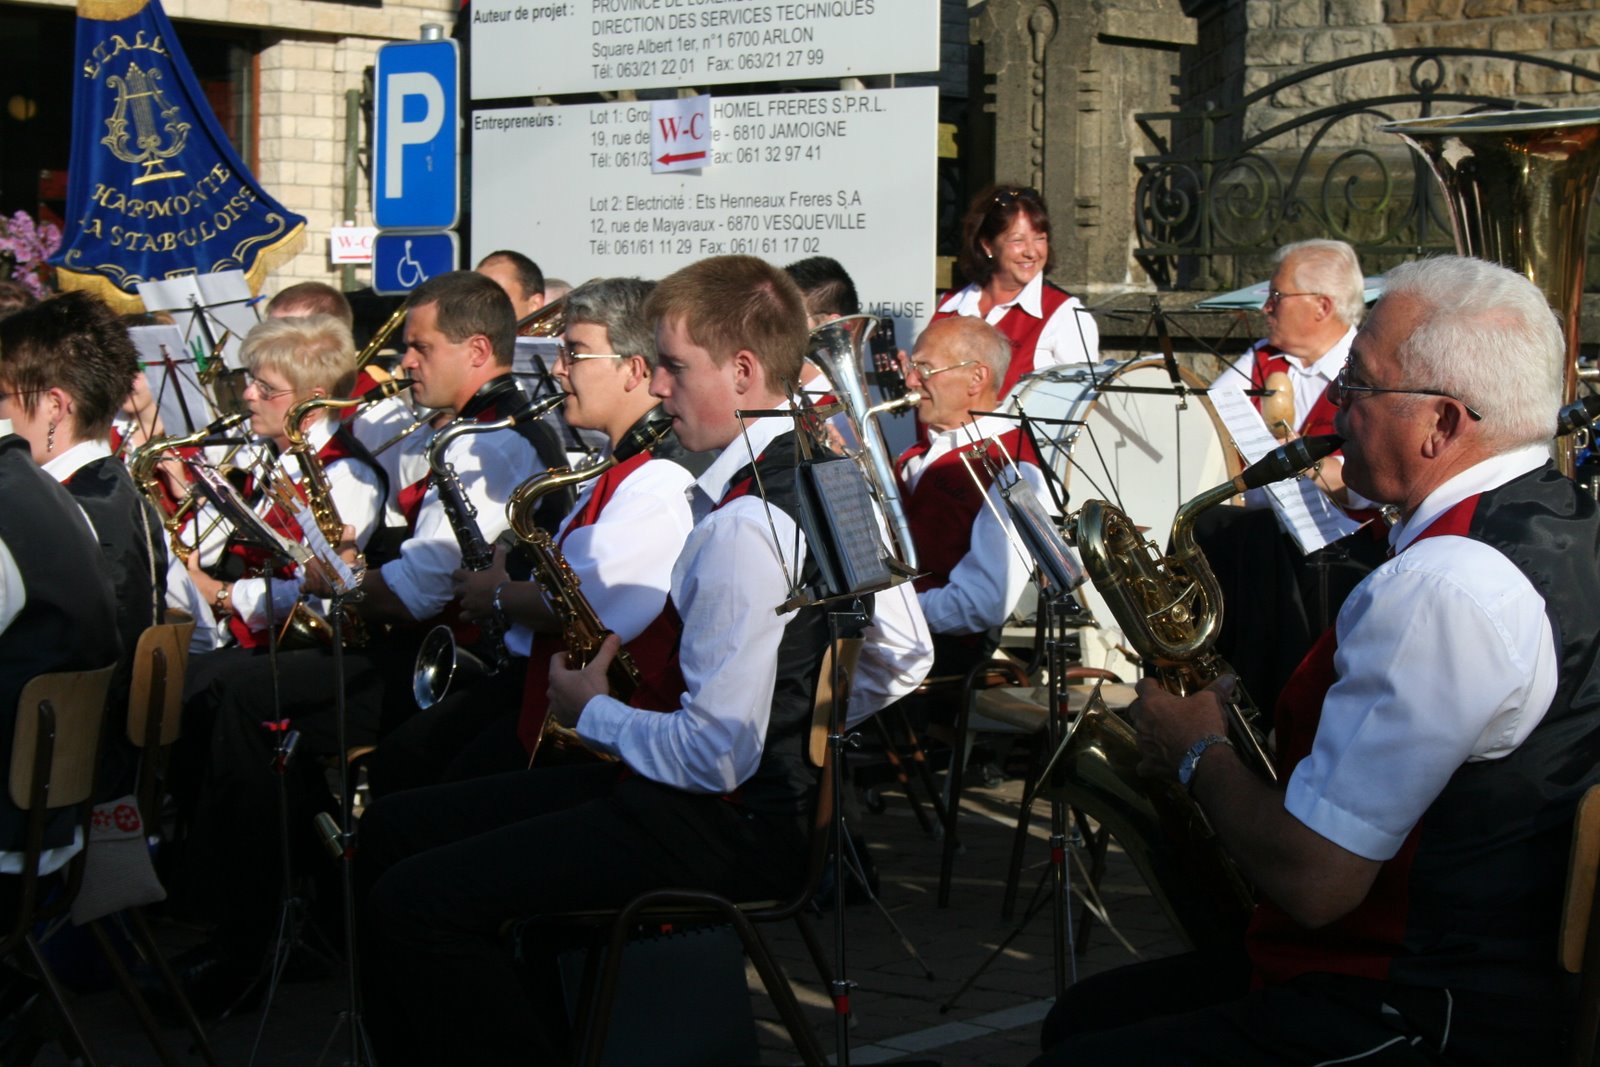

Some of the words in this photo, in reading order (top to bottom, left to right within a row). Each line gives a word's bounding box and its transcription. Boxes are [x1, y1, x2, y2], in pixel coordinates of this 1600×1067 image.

[473, 9, 511, 24] Auteur
[514, 6, 528, 20] de
[532, 3, 567, 23] projet
[592, 0, 660, 14] PROVINCE
[592, 16, 664, 36] DIRECTION
[668, 13, 697, 30] DES
[700, 6, 772, 27] SERVICES
[776, 0, 875, 21] TECHNIQUES
[84, 30, 171, 79] ETALL
[592, 42, 634, 60] Square
[637, 38, 672, 54] Albert
[677, 36, 699, 52] 1er,
[703, 34, 723, 50] n°1
[728, 30, 760, 48] 6700
[762, 27, 814, 45] ARLON
[592, 63, 613, 79] Tél:
[616, 61, 656, 78] 063/21
[661, 59, 676, 75] 22
[680, 58, 694, 74] 01
[707, 56, 734, 72] Fax:
[738, 52, 781, 70] 063/21
[786, 50, 803, 67] 27
[807, 49, 824, 65] 99
[474, 114, 554, 132] Entrepreneurs
[590, 109, 608, 125] Lot
[612, 108, 622, 124] 1:
[714, 101, 764, 119] HOMEL
[768, 98, 827, 117] FRERES
[832, 95, 887, 114] S.P.R.L.
[385, 71, 445, 198] P
[592, 130, 608, 148] 19,
[612, 133, 631, 146] rue
[635, 129, 650, 145] de
[733, 124, 766, 141] 6810
[769, 120, 847, 139] JAMOIGNE
[658, 112, 704, 144] W-C
[590, 152, 611, 168] Tél:
[711, 149, 732, 165] ax:
[736, 147, 760, 164] 061
[765, 145, 781, 162] 32
[785, 145, 802, 161] 97
[805, 144, 821, 161] 41
[92, 163, 230, 219] HARMONIE
[590, 196, 608, 212] Lot
[611, 195, 622, 211] 2:
[626, 194, 684, 211] Electricité
[696, 193, 716, 209] Ets
[720, 192, 785, 209] Henneaux
[789, 191, 832, 207] Freres
[837, 190, 862, 207] S.A
[590, 218, 608, 235] 12,
[611, 220, 630, 233] rue
[634, 218, 649, 233] de
[653, 217, 715, 236] Mayavaux
[727, 215, 759, 231] 6870
[763, 212, 866, 231] VESQUEVILLE
[338, 235, 373, 249] W-C
[589, 239, 611, 255] Tél:
[614, 239, 654, 255] 061/61
[660, 239, 672, 254] 11
[676, 238, 692, 255] 29
[700, 238, 726, 254] Fax:
[784, 237, 799, 253] 17
[803, 236, 820, 253] 02
[868, 301, 924, 318] MEUSE
